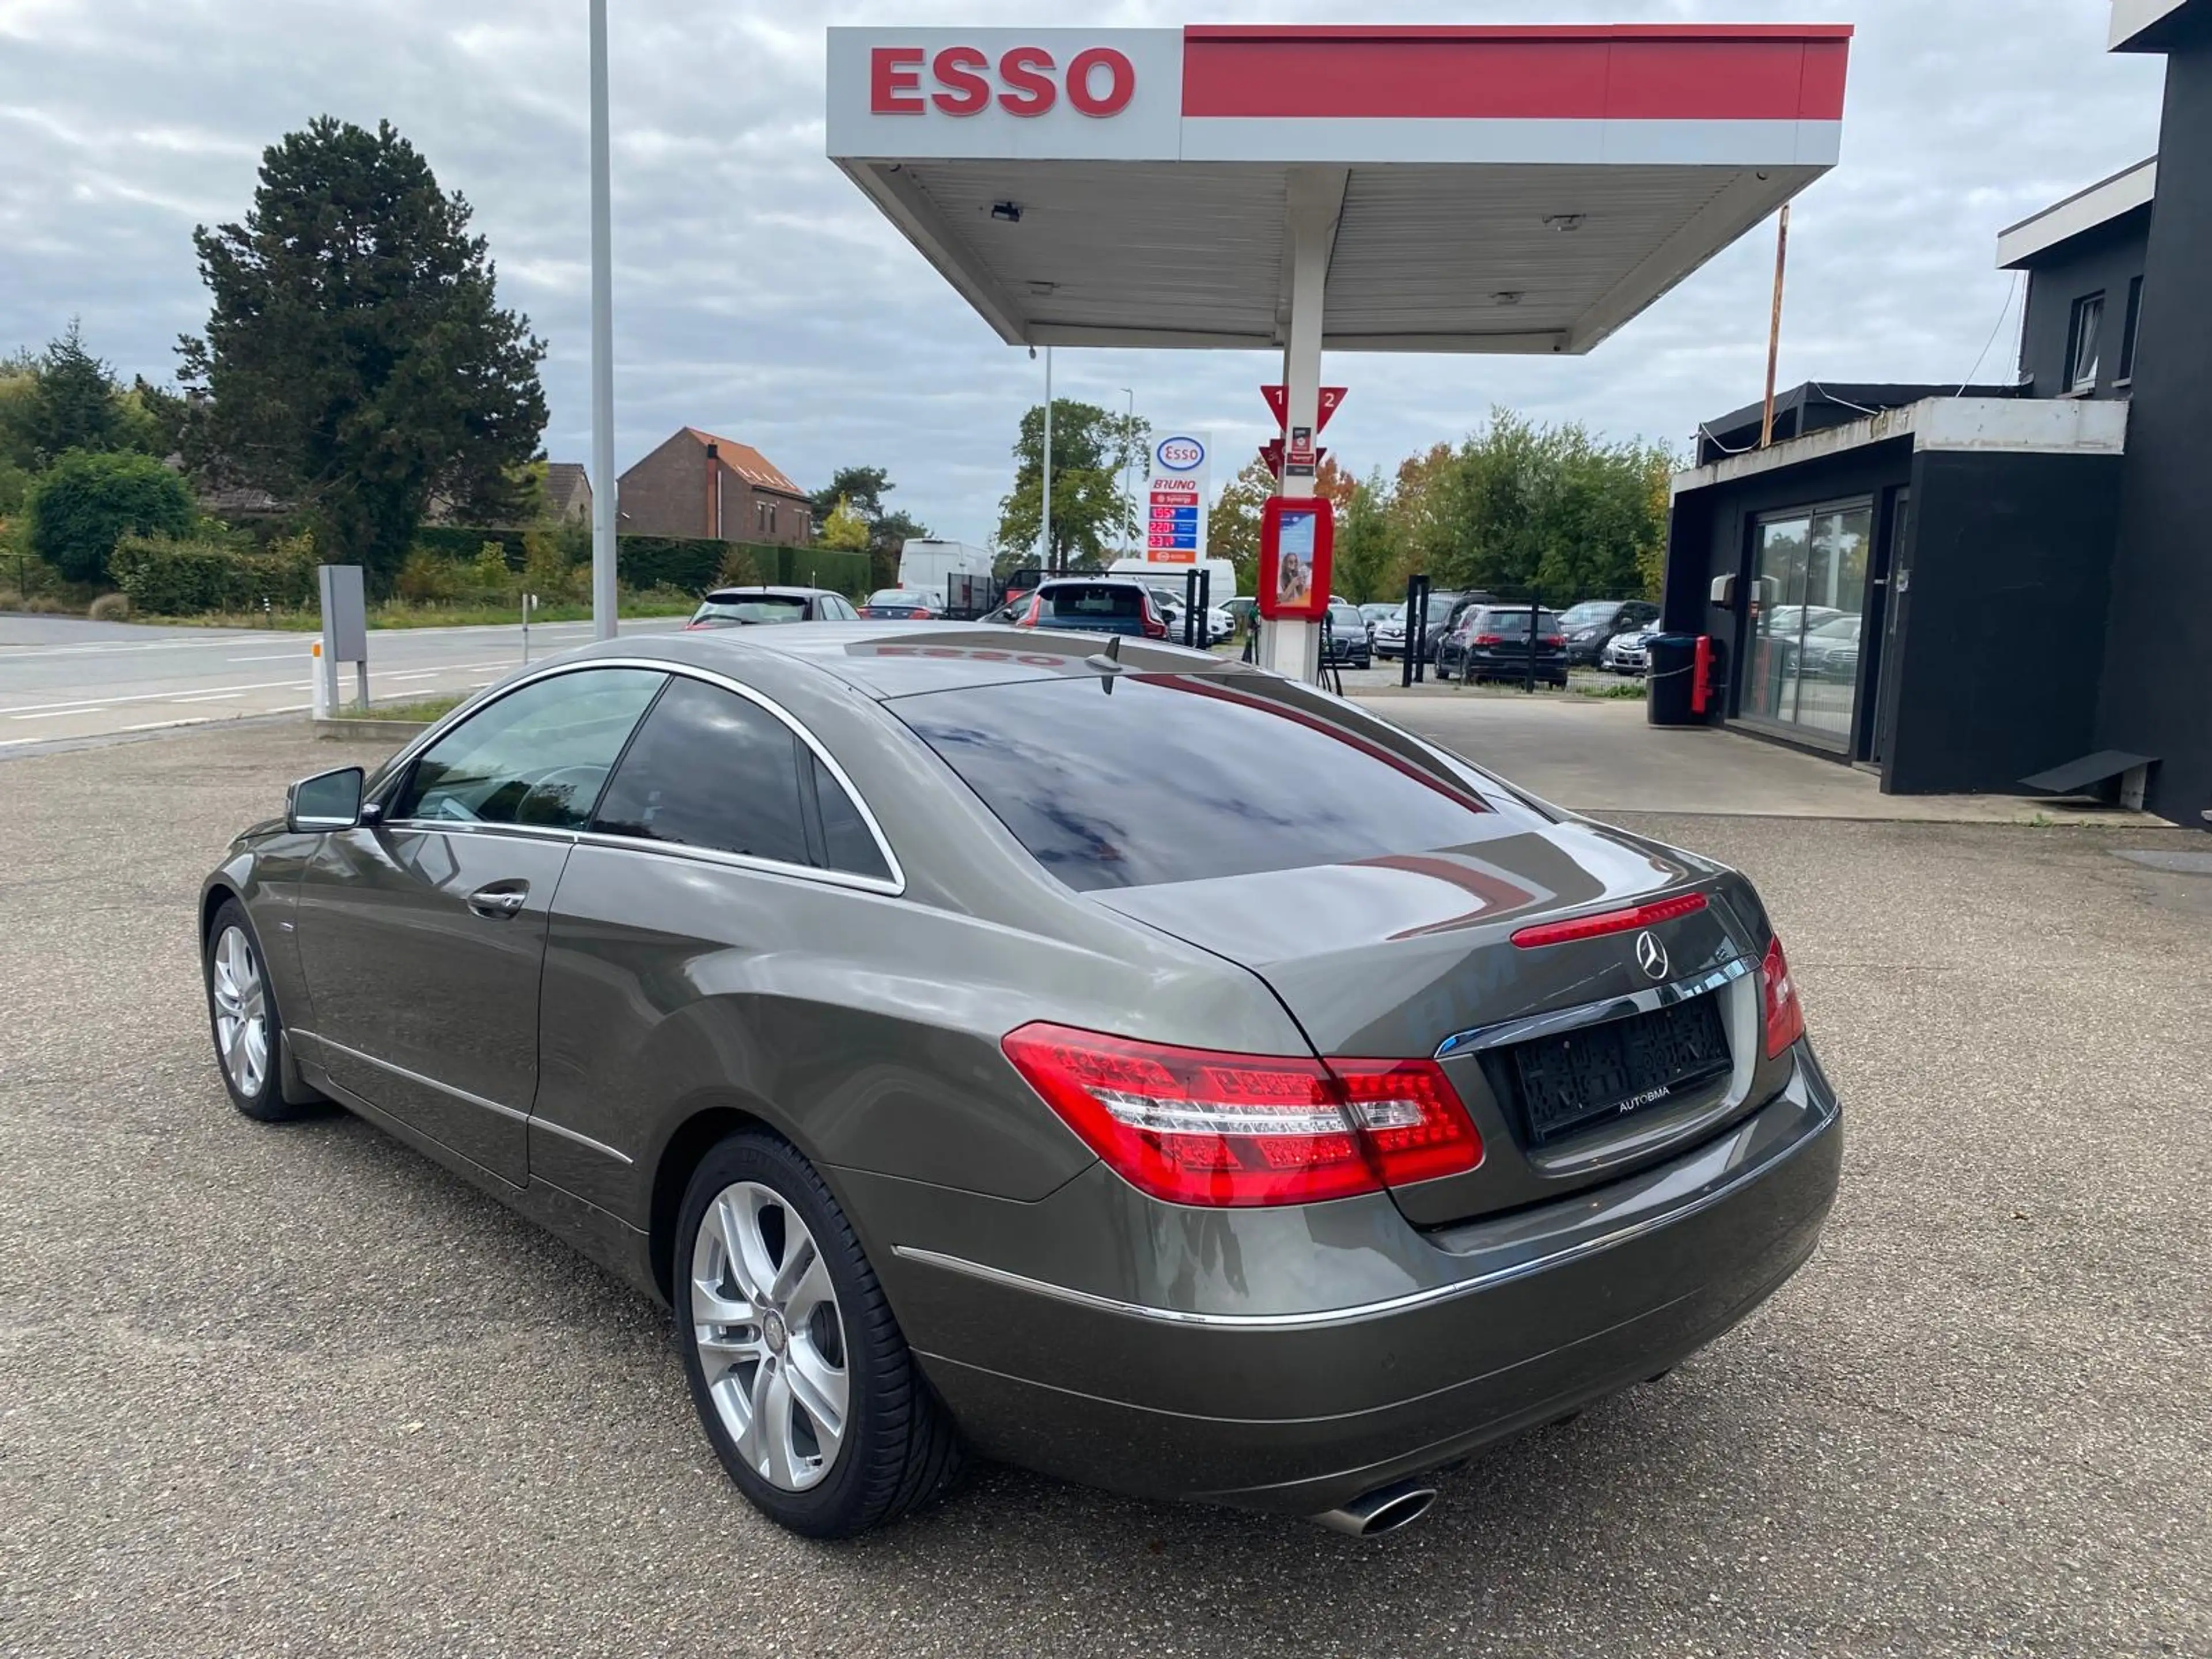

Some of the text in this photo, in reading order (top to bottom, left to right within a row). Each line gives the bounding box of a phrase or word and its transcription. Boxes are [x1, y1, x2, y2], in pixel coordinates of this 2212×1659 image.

[870, 46, 1137, 118] ESSO
[1275, 389, 1283, 405] 1
[1324, 392, 1335, 407] 2
[1619, 1086, 1671, 1113] AUTOBMA
